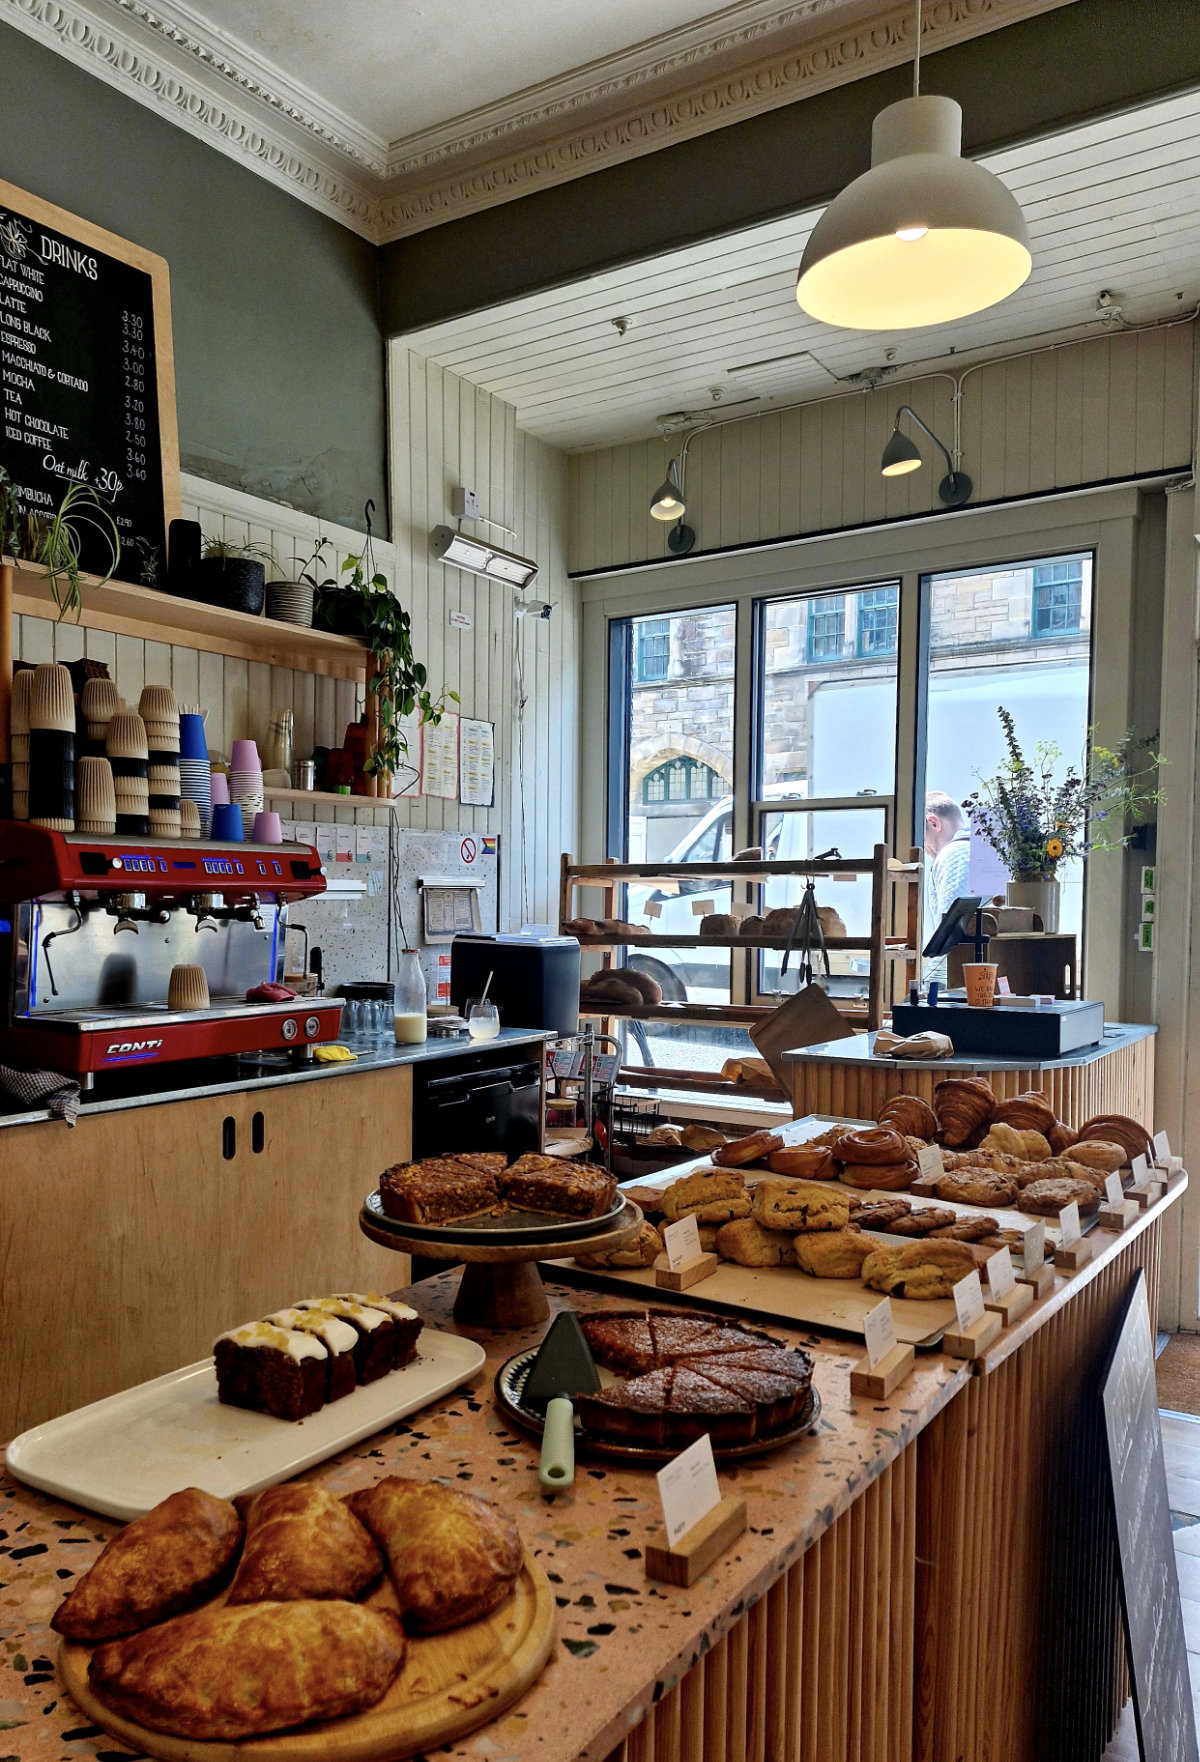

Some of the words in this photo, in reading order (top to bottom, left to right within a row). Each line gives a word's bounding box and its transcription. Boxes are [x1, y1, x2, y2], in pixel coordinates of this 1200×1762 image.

[41, 235, 98, 280] DRINKS
[20, 263, 45, 285] WHITE
[0, 291, 26, 313] LATTE
[0, 310, 21, 330] LONG
[23, 320, 52, 343] BLACK
[122, 310, 143, 329] 3.30
[1, 330, 36, 354] ESPRESSO
[122, 323, 143, 341] 3.30
[122, 340, 145, 360] 3.40
[2, 350, 47, 377] MACCHIATO
[47, 368, 56, 379] &
[57, 371, 89, 392] CORTADO
[122, 357, 145, 376] 3.00
[2, 369, 36, 391] MOCHA
[125, 375, 145, 393] 2.80
[3, 388, 22, 405] TEA
[124, 395, 145, 413] 3.20
[5, 406, 22, 423] HOT
[24, 414, 69, 440] CHOCOLATE
[124, 413, 146, 431] 3.80
[5, 425, 22, 441] ICED
[23, 432, 52, 451] COFFEE
[126, 430, 146, 447] 2.50
[126, 447, 146, 466] 3.60
[42, 454, 65, 474] Oat
[66, 459, 91, 481] milk
[126, 464, 146, 481] 3.60
[9, 485, 54, 507] MBUCHA
